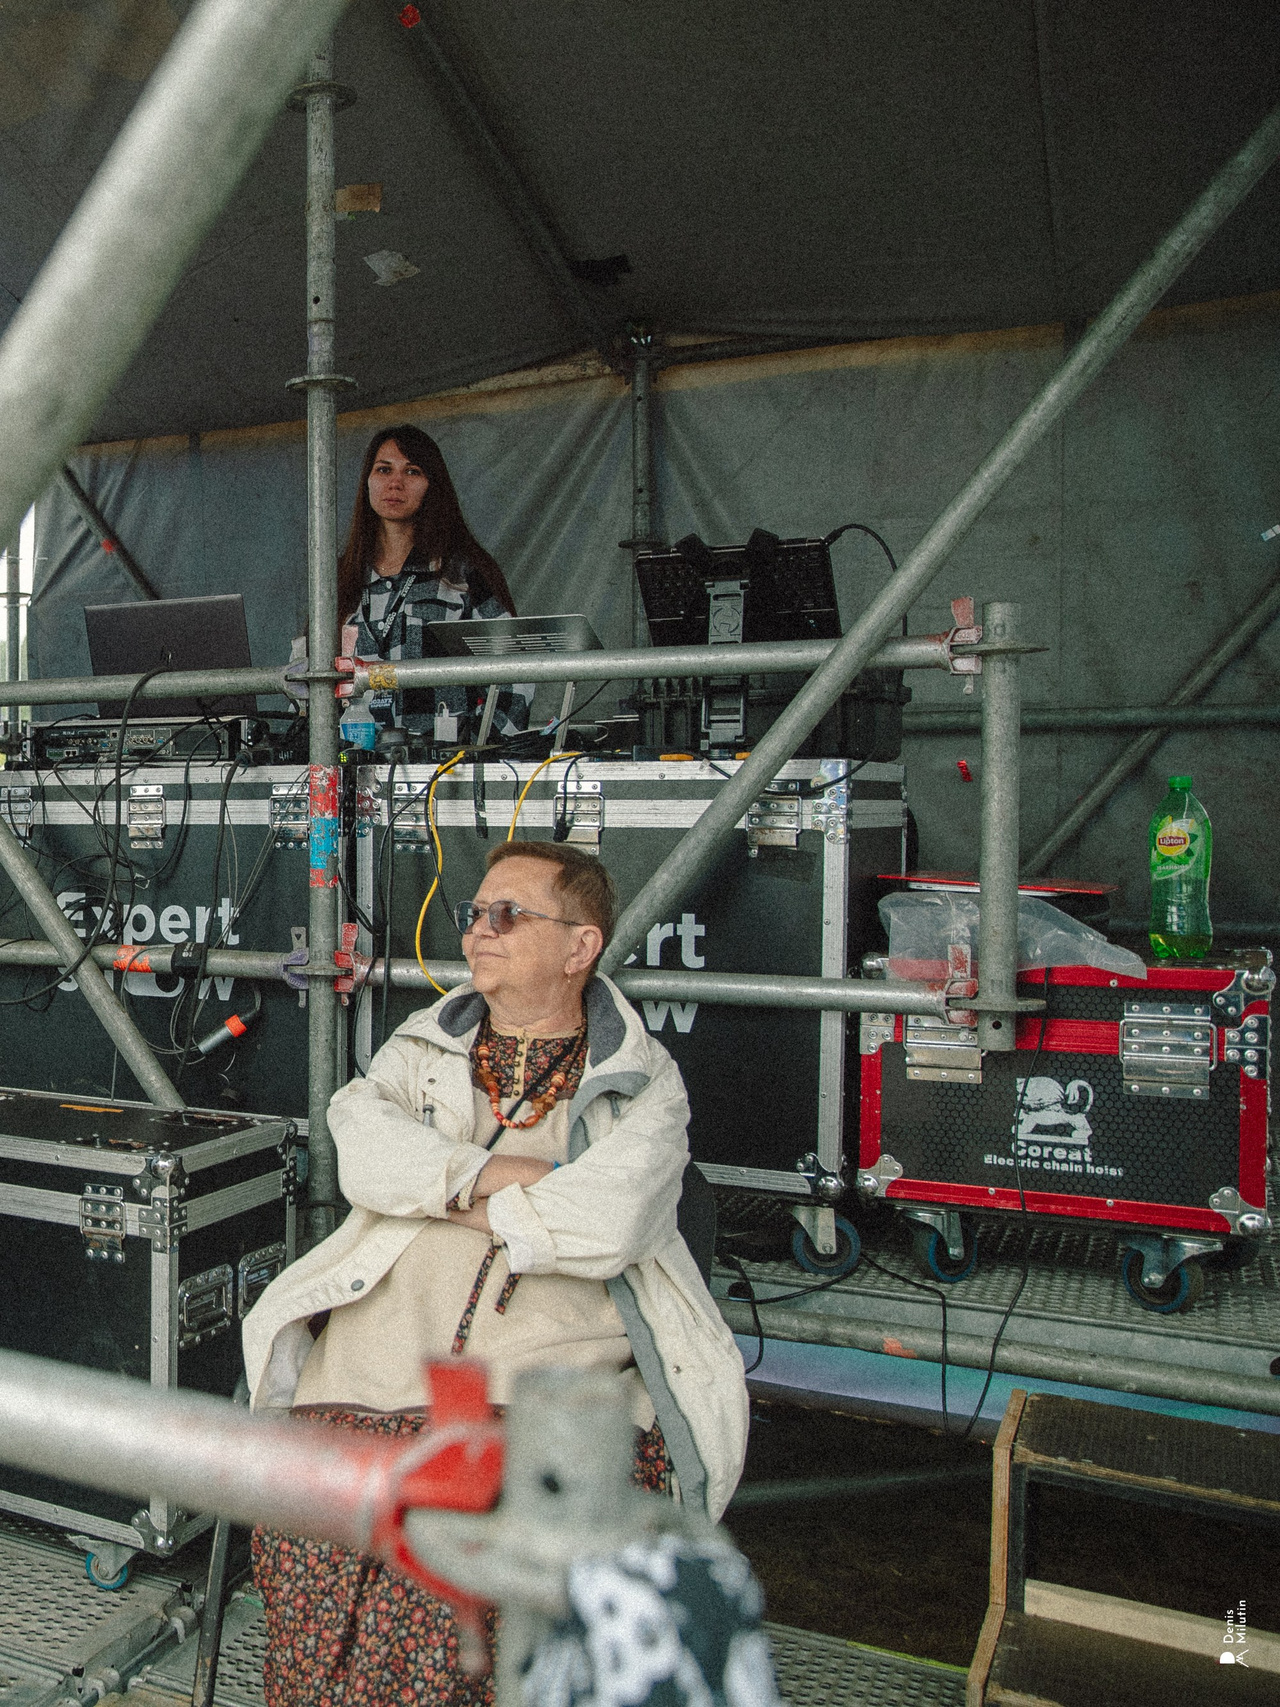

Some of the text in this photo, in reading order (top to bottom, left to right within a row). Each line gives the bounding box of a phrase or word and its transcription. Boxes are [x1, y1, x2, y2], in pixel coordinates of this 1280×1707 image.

[1160, 836, 1184, 846] Lipton
[1011, 1141, 1092, 1162] Coreat
[1043, 1160, 1083, 1173] chain
[1086, 1163, 1124, 1177] hoist
